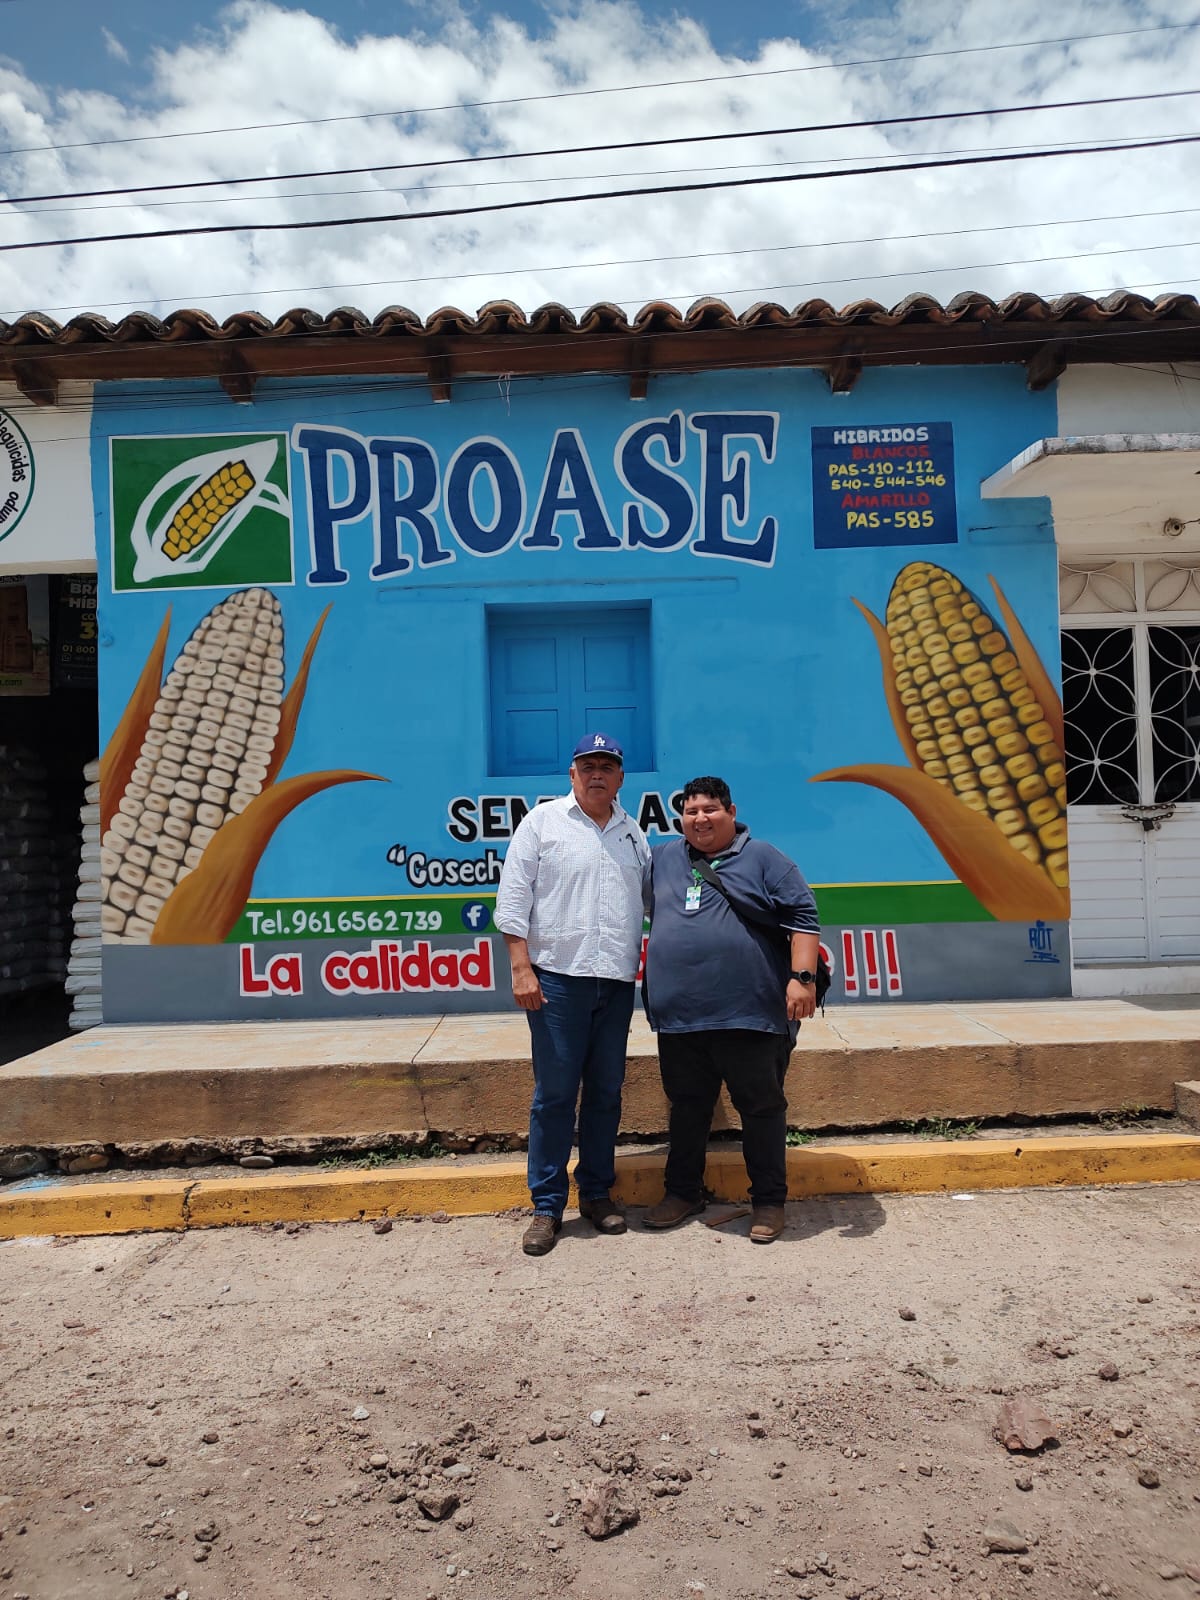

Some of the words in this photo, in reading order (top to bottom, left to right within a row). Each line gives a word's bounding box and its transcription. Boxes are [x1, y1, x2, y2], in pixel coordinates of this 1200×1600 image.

[833, 427, 929, 444] HIBRIDOS
[852, 445, 929, 460] BLANCOS
[292, 409, 779, 586] PROASE
[841, 492, 930, 509] AMARILLO
[593, 735, 606, 747] LA
[240, 943, 303, 997] La
[321, 937, 495, 996] calidad
